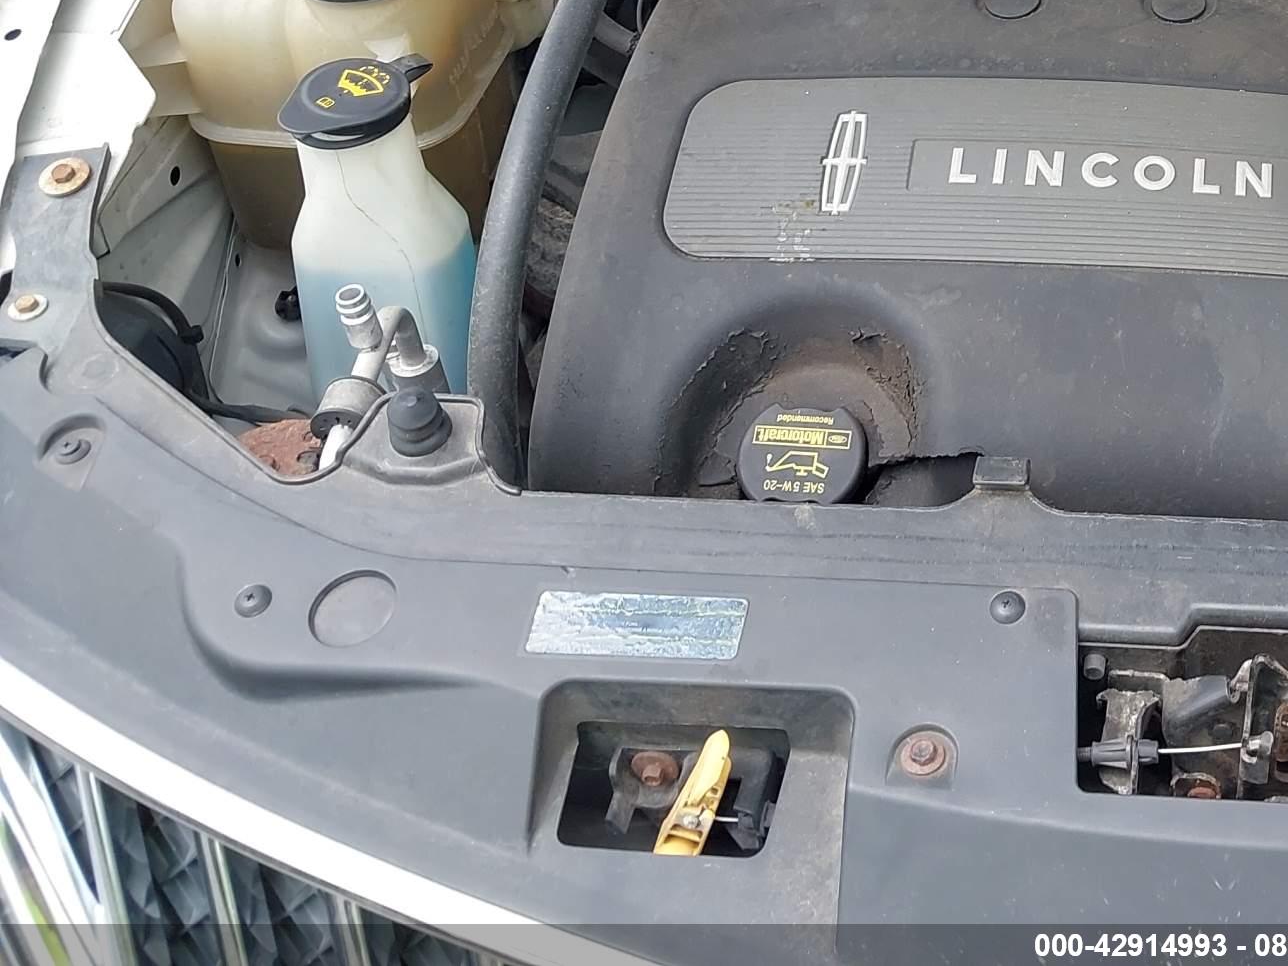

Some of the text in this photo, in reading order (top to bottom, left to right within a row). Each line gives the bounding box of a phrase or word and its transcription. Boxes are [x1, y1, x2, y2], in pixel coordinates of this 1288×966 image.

[948, 147, 1274, 198] LINCOLN
[776, 413, 835, 425] Recommended
[757, 427, 826, 445] Motorcraft
[803, 482, 825, 494] SAE
